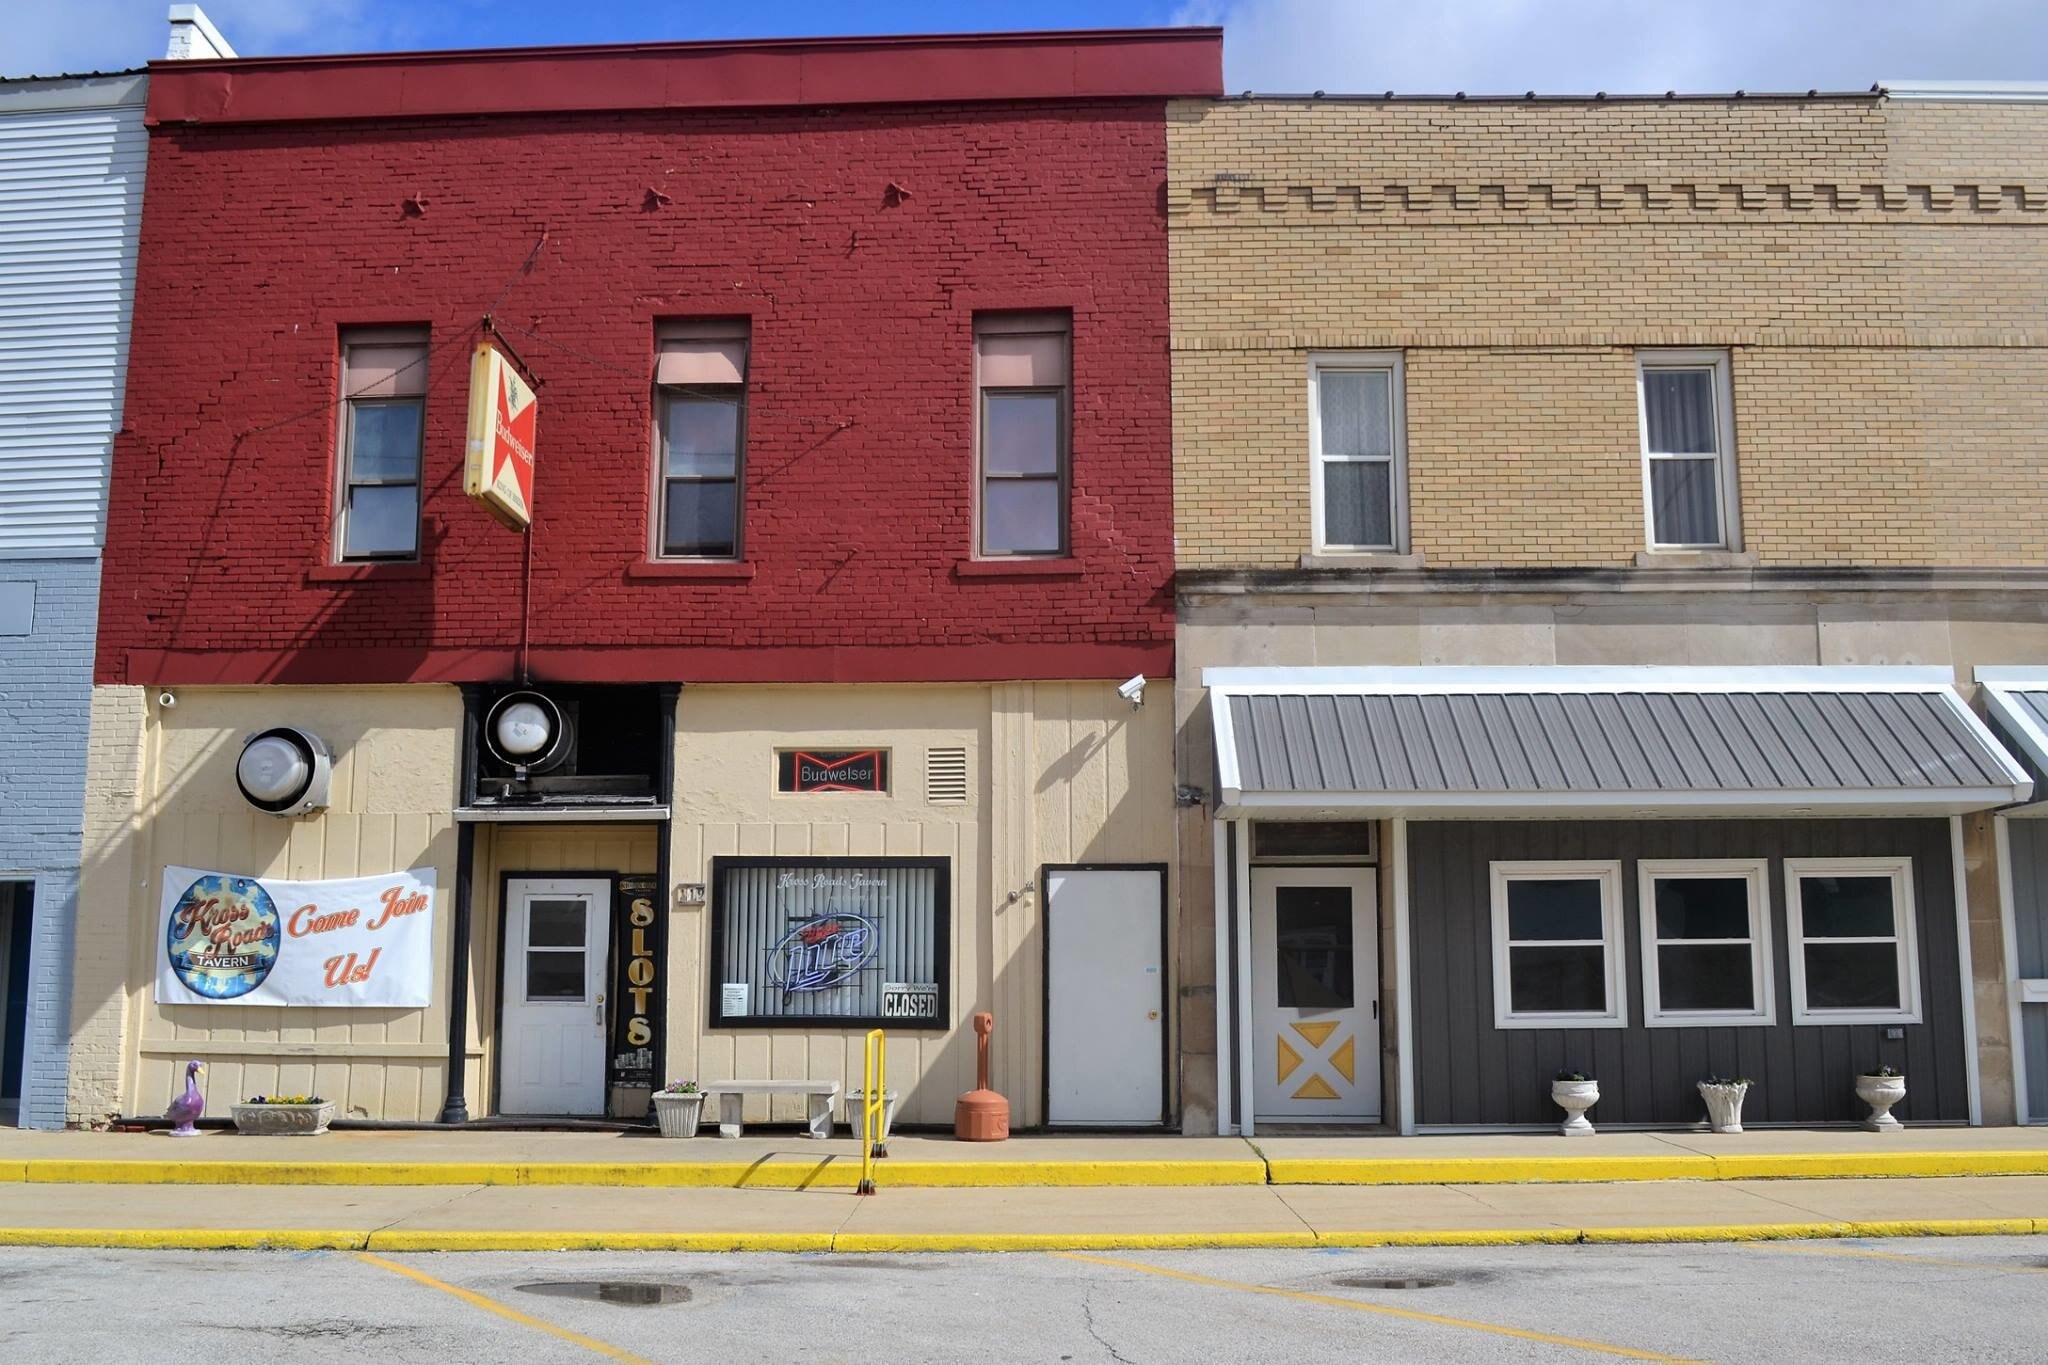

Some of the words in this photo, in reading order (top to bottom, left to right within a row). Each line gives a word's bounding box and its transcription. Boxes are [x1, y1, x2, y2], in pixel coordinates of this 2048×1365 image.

[496, 409, 533, 466] Budweiser
[802, 766, 873, 782] Budweiser
[777, 872, 809, 889] Kross
[812, 873, 847, 889] Roads
[849, 873, 888, 890] Tavern
[175, 898, 250, 940] Kross
[287, 903, 360, 939] Come
[366, 886, 429, 930] Join
[206, 922, 275, 959] Roads
[197, 955, 249, 968] TAVERN
[323, 947, 383, 989] Us!
[627, 898, 655, 1046] SLOTS
[885, 993, 936, 1018] CLOSED
